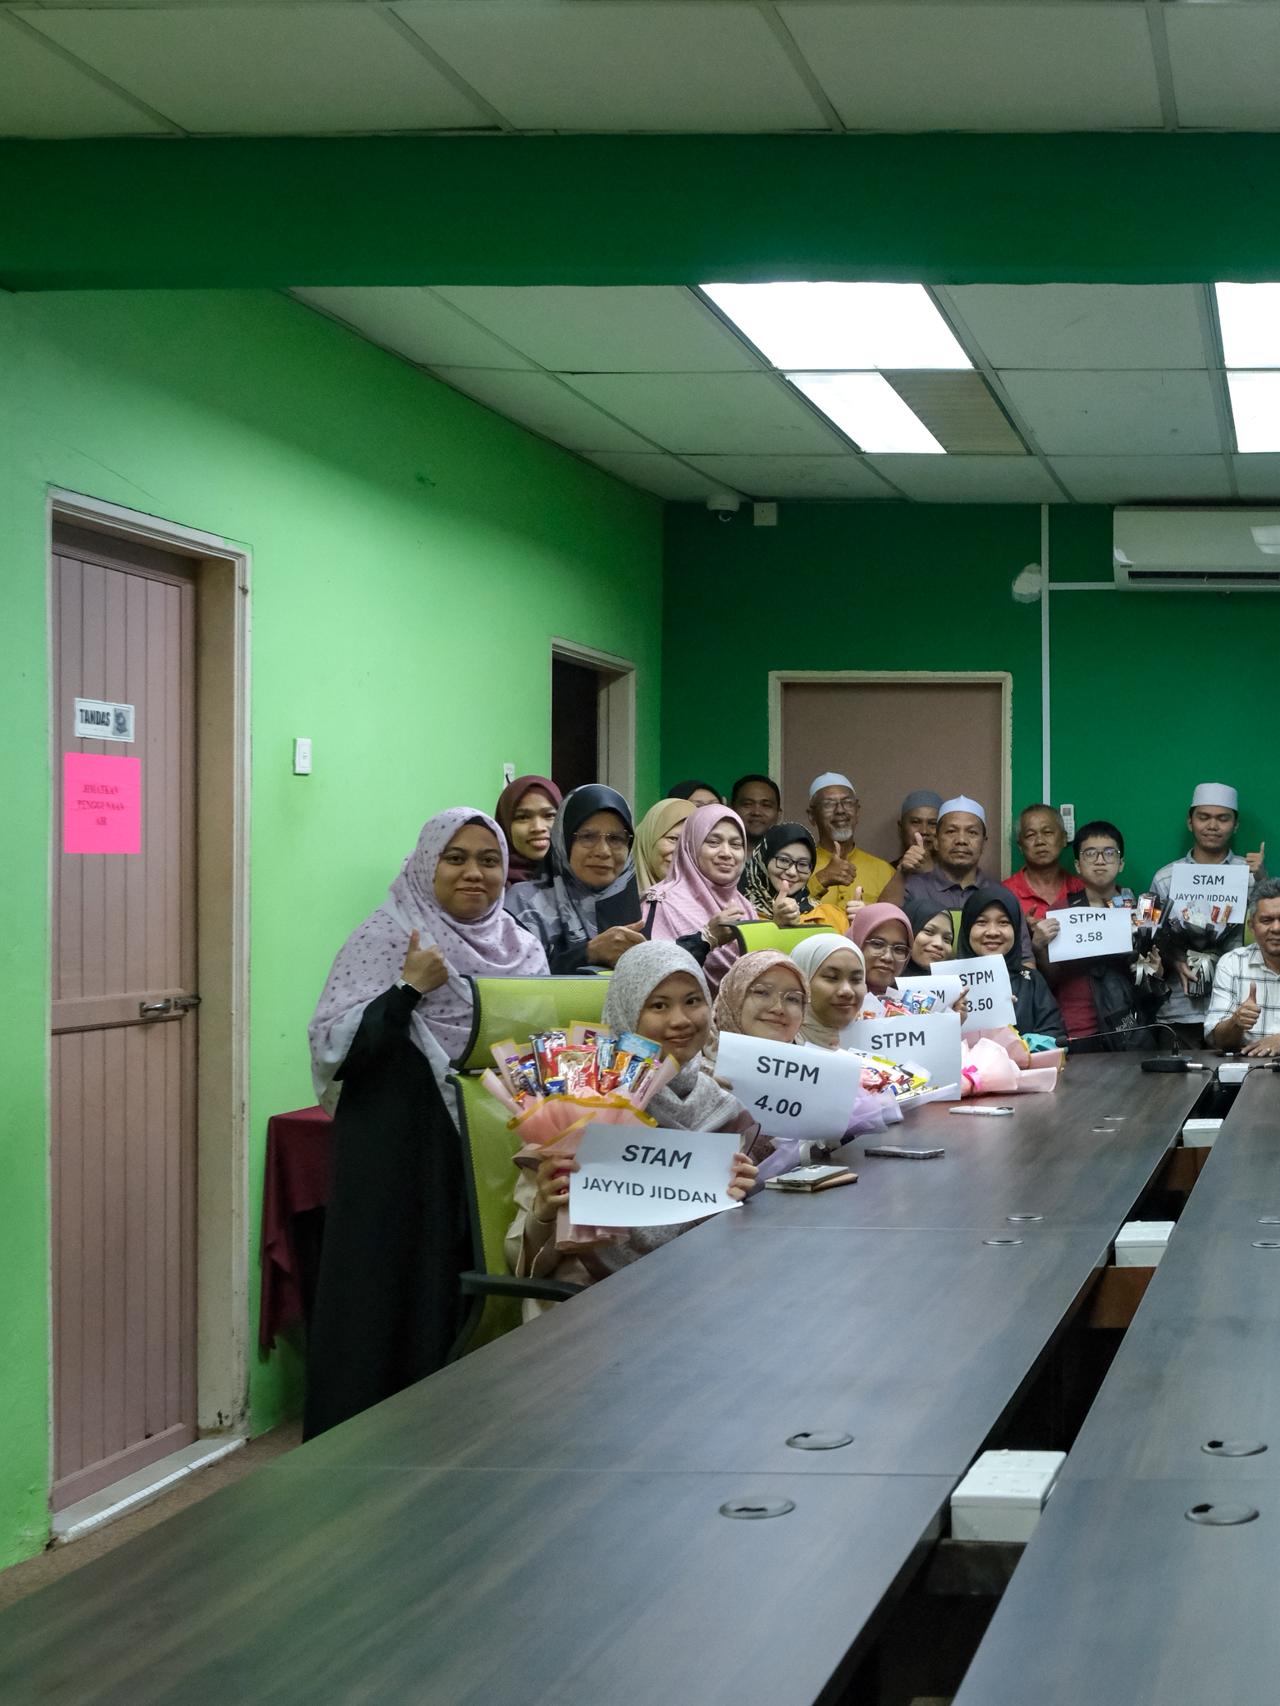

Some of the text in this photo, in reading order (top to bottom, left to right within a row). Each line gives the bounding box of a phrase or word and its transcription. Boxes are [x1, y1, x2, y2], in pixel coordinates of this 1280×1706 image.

[79, 708, 111, 727] TANDAS
[1192, 874, 1225, 886] STAM
[1069, 913, 1106, 924] STPM
[1075, 932, 1103, 944] 3.58
[959, 969, 994, 987] STPM
[966, 997, 993, 1013] 3.50
[871, 1030, 925, 1050] STPM
[756, 1055, 820, 1085] STPM
[754, 1094, 803, 1119] 4.00
[621, 1144, 693, 1170] STAM
[582, 1176, 717, 1204] JAYYID JIDDAN
